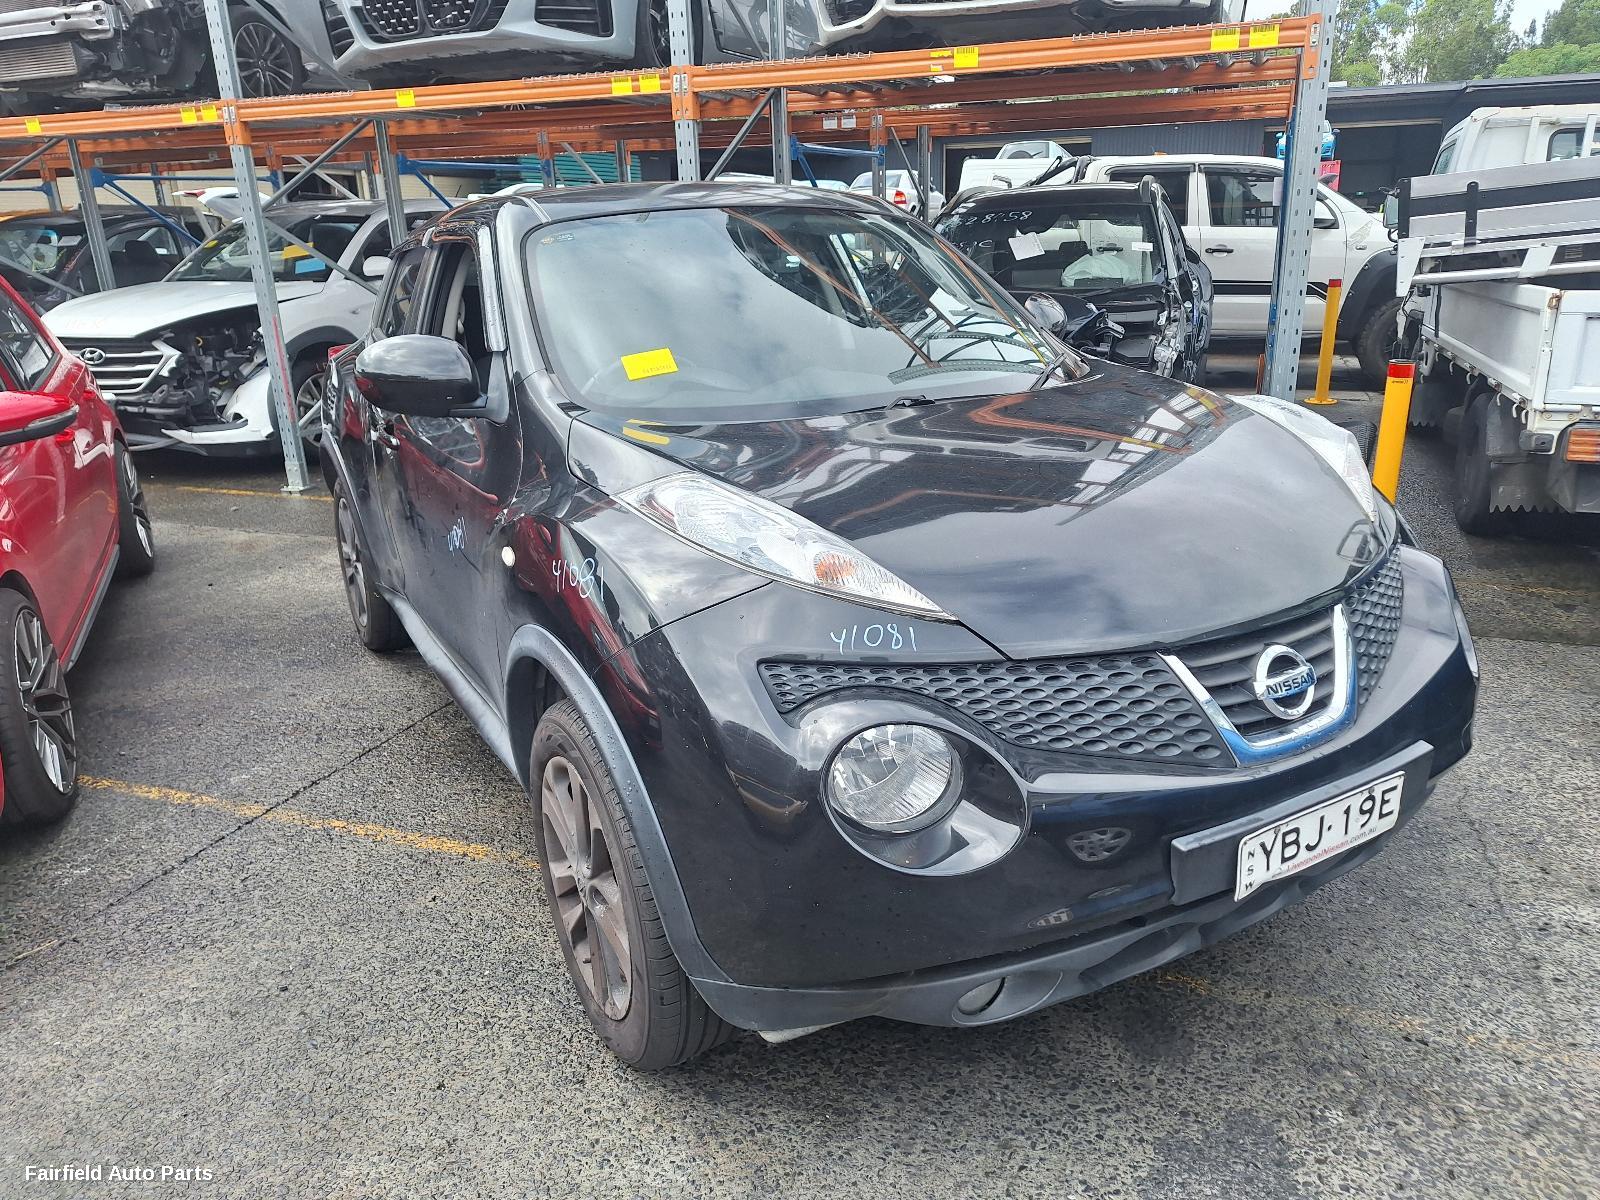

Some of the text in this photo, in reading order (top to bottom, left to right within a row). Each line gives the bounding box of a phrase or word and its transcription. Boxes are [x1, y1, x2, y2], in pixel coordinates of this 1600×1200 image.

[552, 558, 605, 601] 41081
[830, 623, 917, 655] 41081
[1266, 668, 1315, 695] NISSAN
